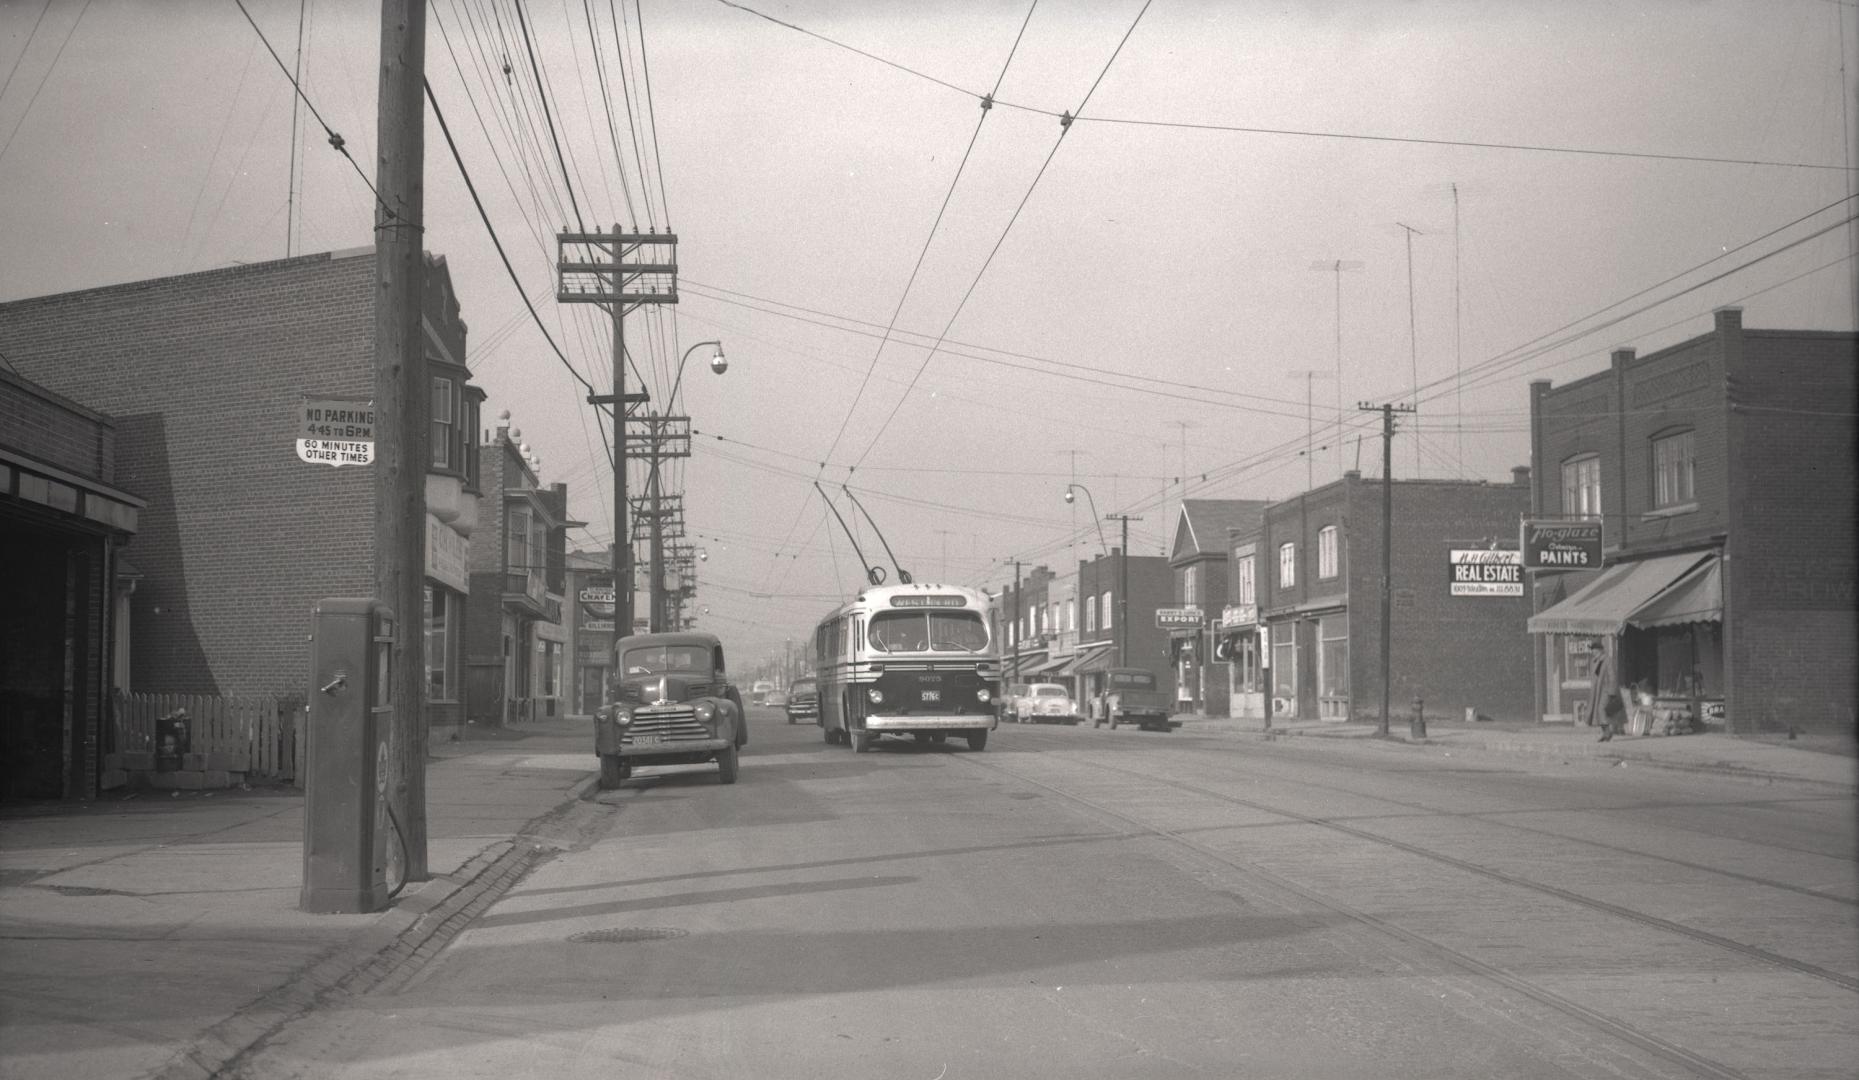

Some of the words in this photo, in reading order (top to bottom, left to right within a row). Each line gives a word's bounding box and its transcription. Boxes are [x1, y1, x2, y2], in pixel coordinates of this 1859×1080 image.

[306, 408, 322, 421] NO
[325, 409, 374, 424] PARKING
[333, 428, 344, 437] TO
[304, 439, 318, 449] 60
[322, 440, 368, 453] MINUTES
[305, 449, 337, 460] OTHER
[340, 452, 369, 463] TIMES
[1540, 551, 1588, 565] PAINTS
[1455, 564, 1482, 581] REAL
[1483, 565, 1520, 582] ESTATE
